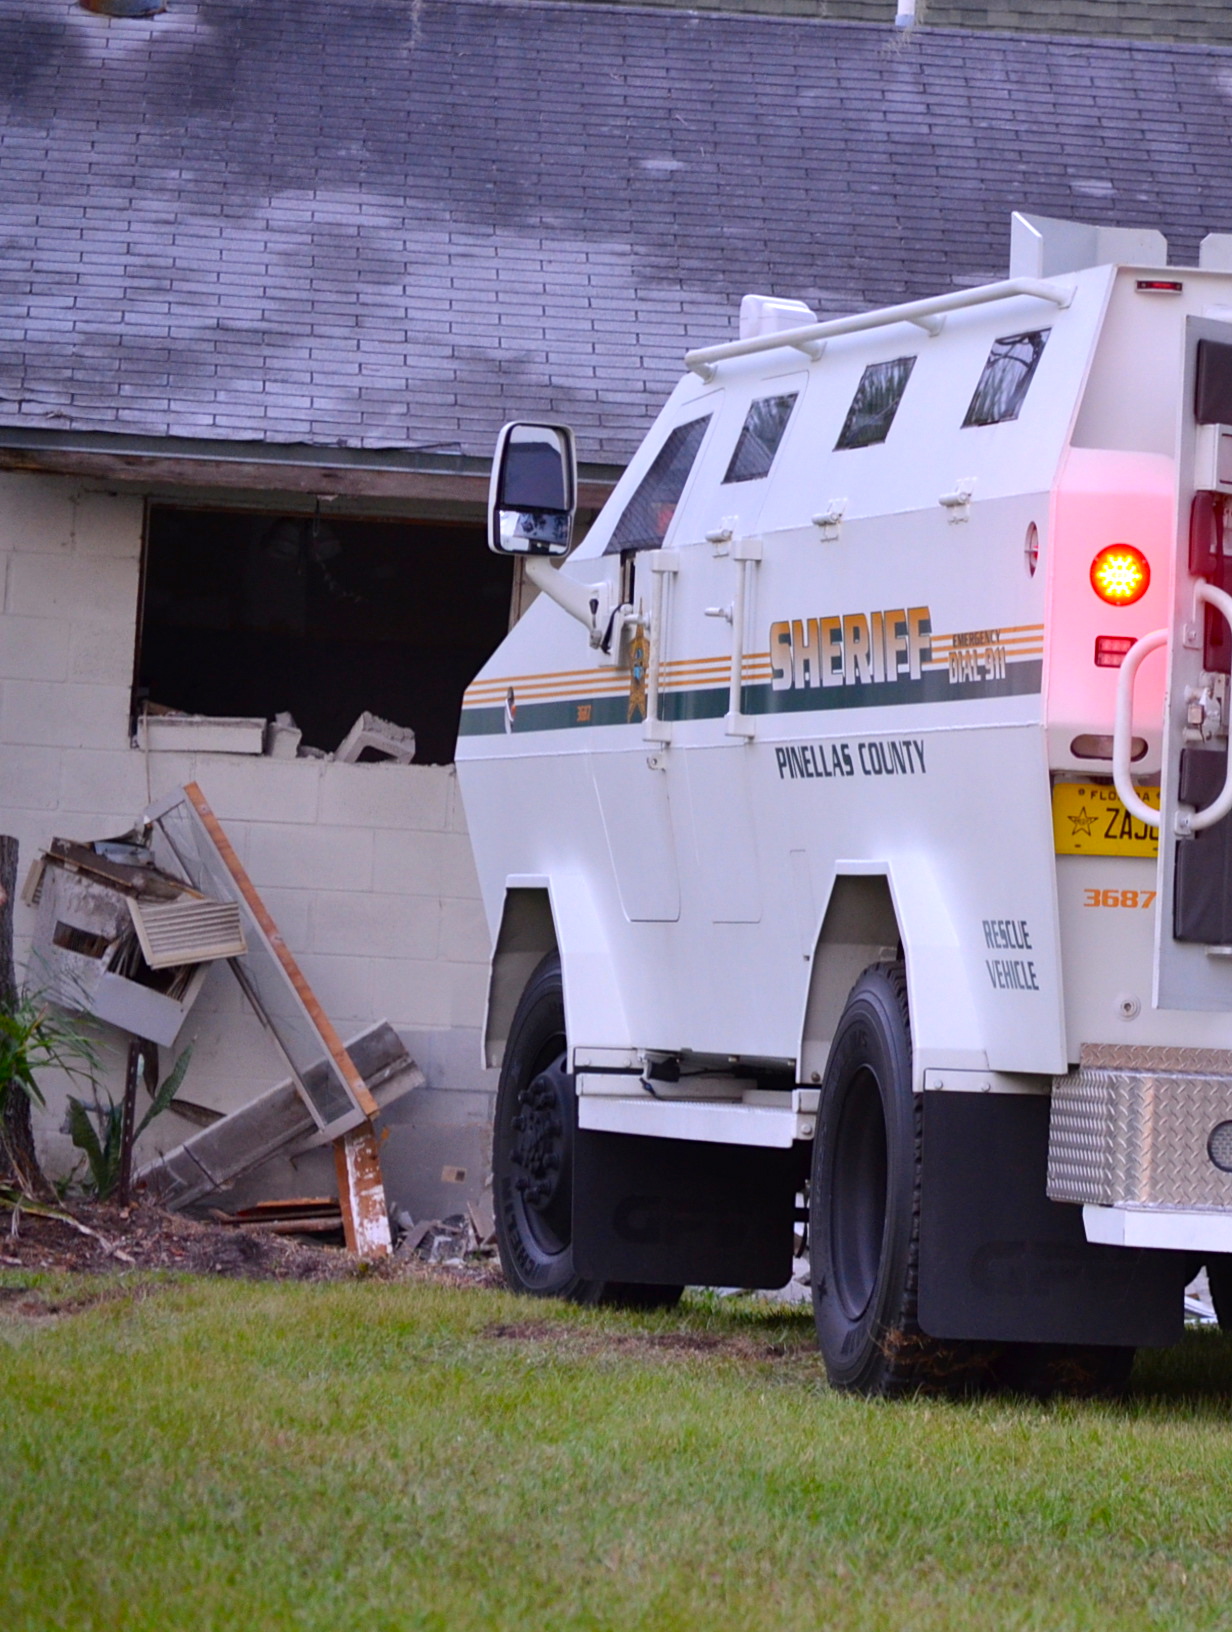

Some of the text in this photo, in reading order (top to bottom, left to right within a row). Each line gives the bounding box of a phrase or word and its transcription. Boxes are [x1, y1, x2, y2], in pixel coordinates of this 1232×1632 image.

[769, 606, 933, 691] SHERIFF
[952, 629, 1000, 648] EMERGENCY
[948, 646, 1006, 684] DIAL 911
[775, 740, 926, 779] PINELLAS COUNTY
[1090, 790, 1150, 801] FLOA
[1083, 889, 1157, 908] 3687
[982, 920, 1032, 949] RESCUE
[985, 959, 1039, 990] VEHICLE
